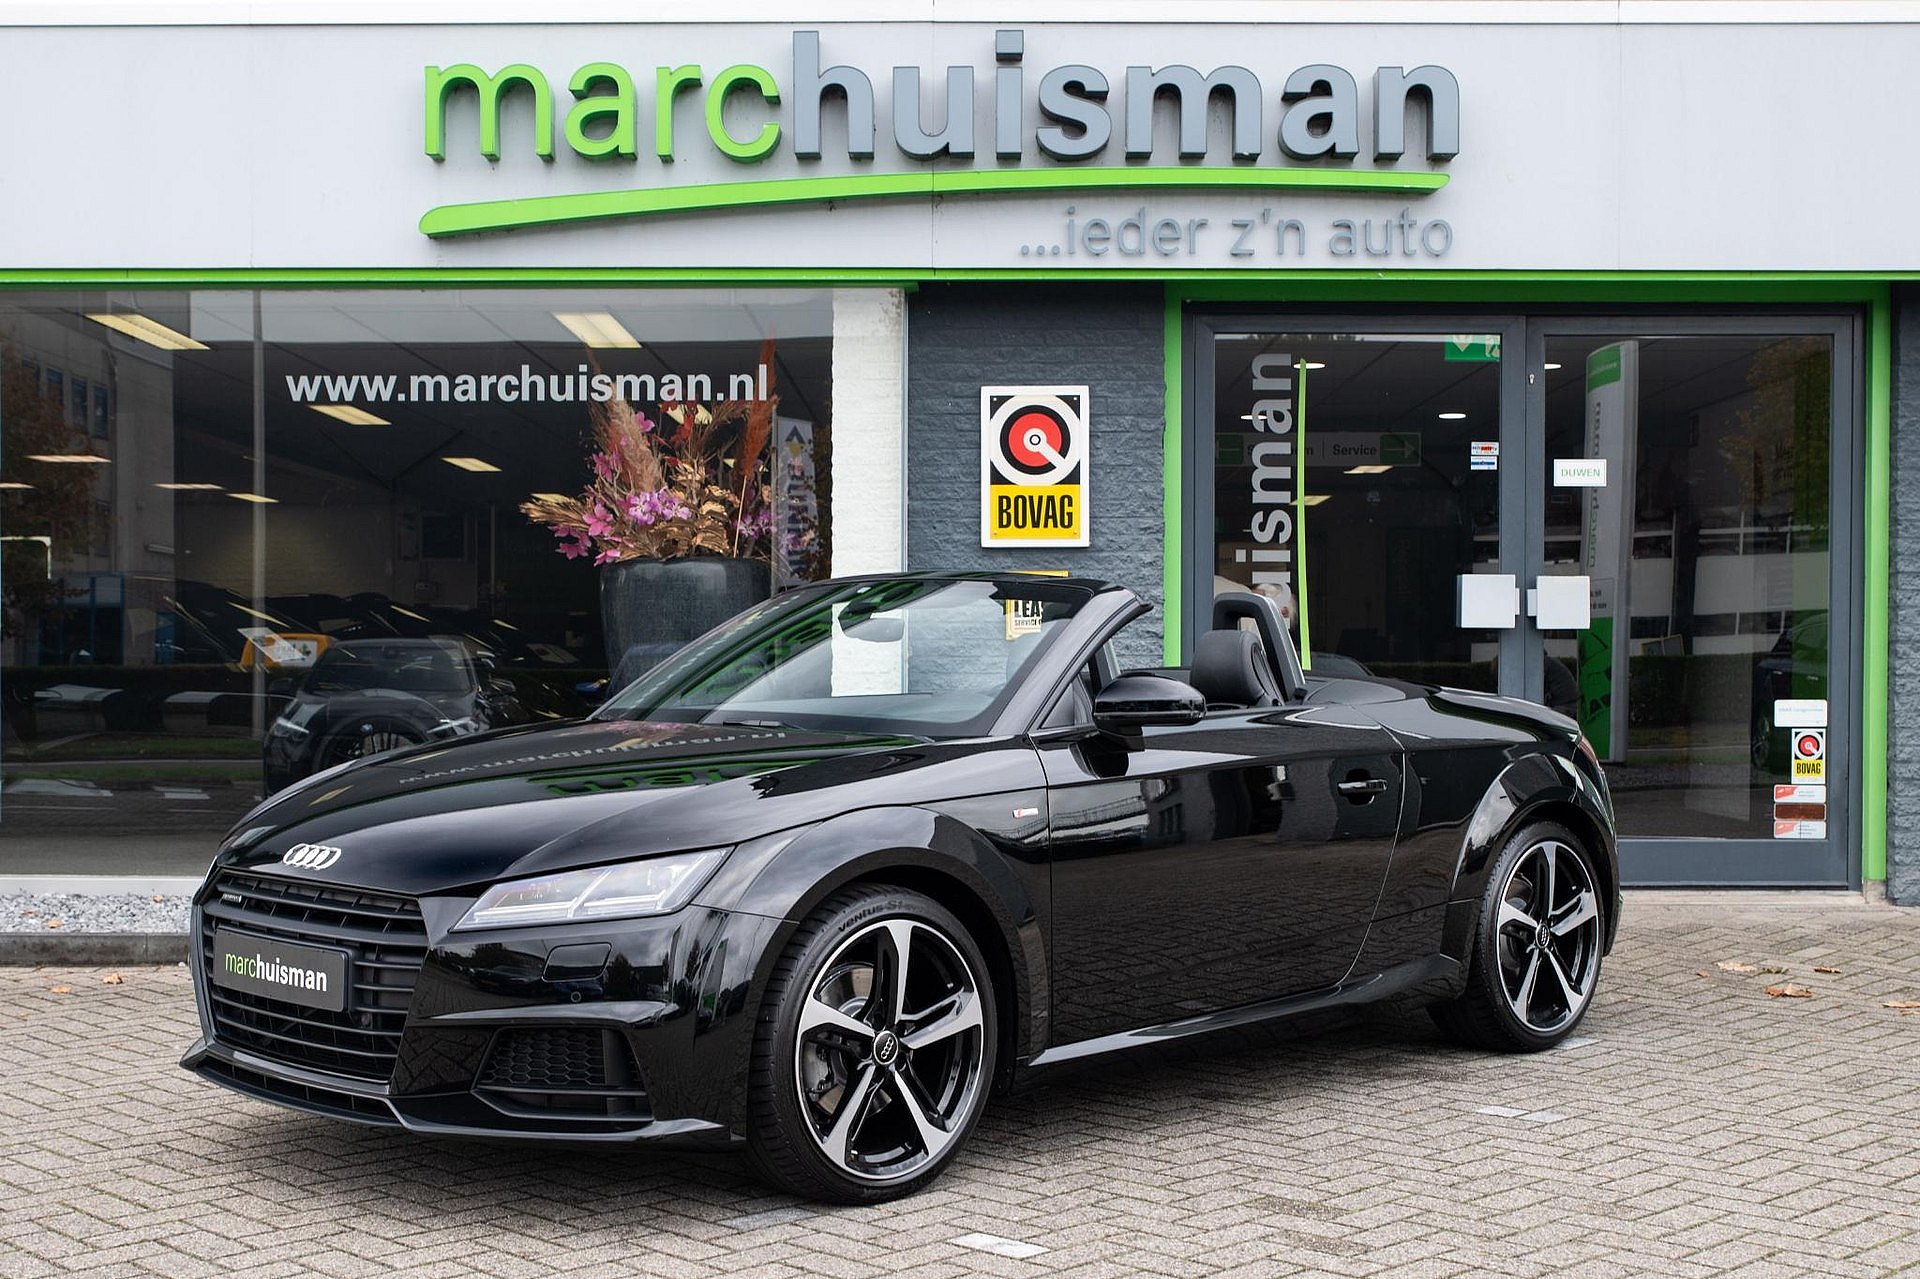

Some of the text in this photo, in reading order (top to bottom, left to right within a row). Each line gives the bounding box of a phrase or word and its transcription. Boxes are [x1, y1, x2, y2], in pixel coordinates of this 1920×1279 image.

[1230, 207, 1306, 256] z'n
[1328, 206, 1453, 256] auto
[285, 364, 768, 401] www.marchuisman.nl
[1332, 443, 1377, 456] Service
[1561, 467, 1601, 478] DUWEN
[1236, 352, 1293, 629] uisman
[998, 494, 1073, 529] BOVAG
[1014, 600, 1043, 618] LEA
[1796, 762, 1821, 775] BOVAG
[225, 953, 328, 992] marchuisman
